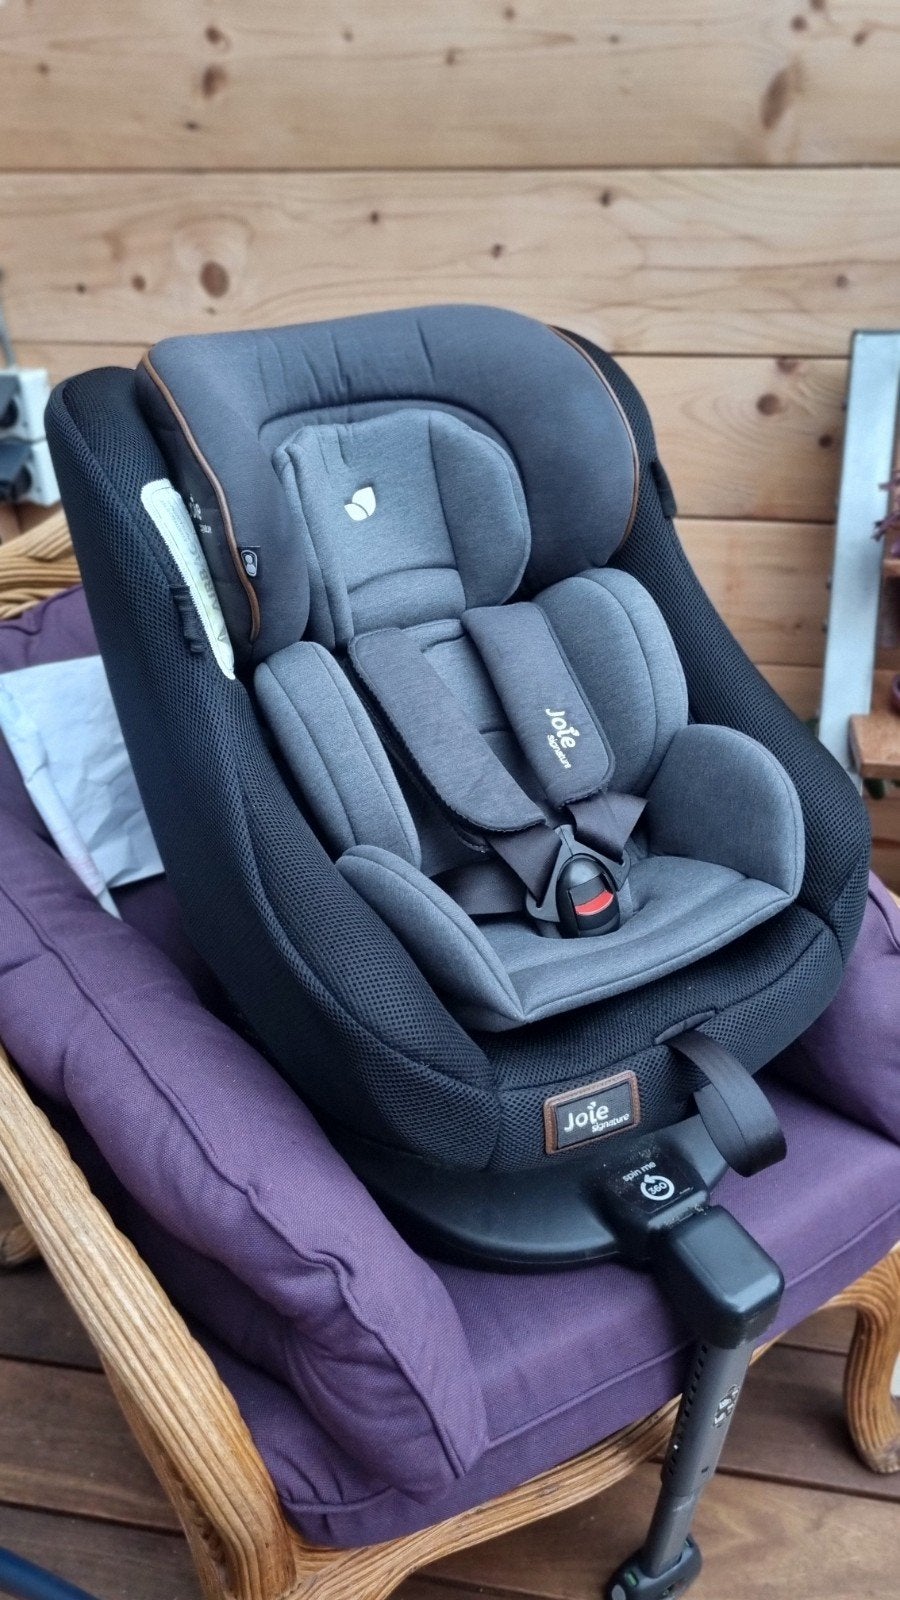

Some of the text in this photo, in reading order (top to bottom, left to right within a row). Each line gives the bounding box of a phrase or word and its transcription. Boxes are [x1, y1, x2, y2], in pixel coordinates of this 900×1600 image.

[545, 708, 579, 748] Joie
[564, 1101, 609, 1132] Joie
[591, 1113, 629, 1132] signature
[622, 1161, 656, 1182] spin me
[648, 1182, 667, 1195] 360
